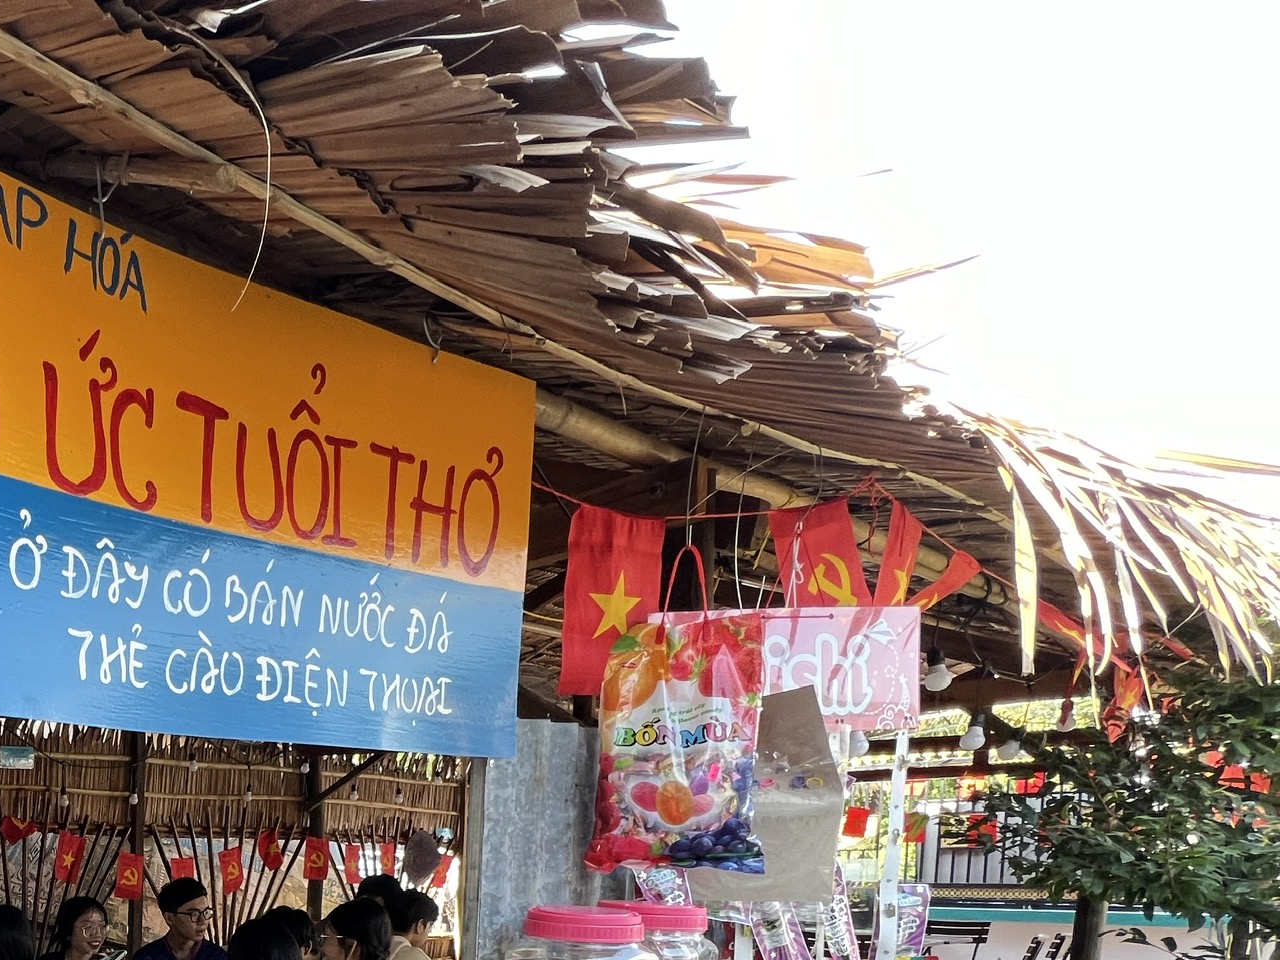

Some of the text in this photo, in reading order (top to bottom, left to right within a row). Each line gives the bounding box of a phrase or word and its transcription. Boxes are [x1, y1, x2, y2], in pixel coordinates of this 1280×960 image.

[65, 217, 149, 313] HÓA
[42, 329, 159, 514] ỨC
[175, 362, 357, 548] TUỔI
[9, 509, 454, 654] Ở ĐÂY CÓ BÁN NƯỚC ĐÁ
[67, 623, 453, 725] THẺ CÀO ĐIỆN THOẠI
[614, 715, 751, 748] BỐN MÙA
